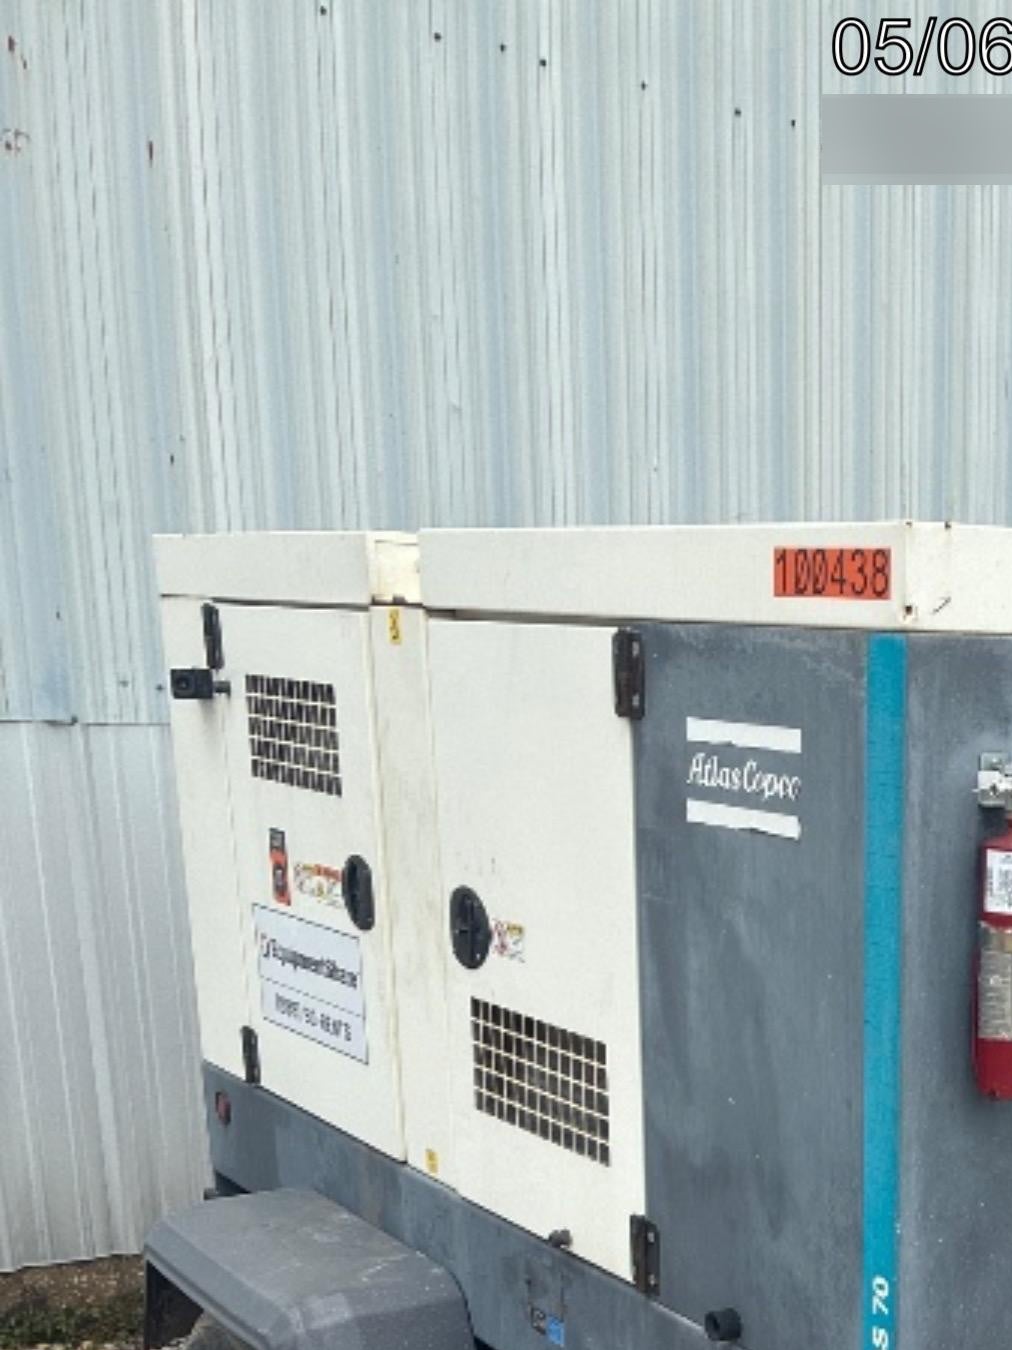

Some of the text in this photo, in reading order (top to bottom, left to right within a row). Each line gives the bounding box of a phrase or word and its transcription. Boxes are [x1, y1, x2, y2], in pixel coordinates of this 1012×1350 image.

[775, 549, 890, 597] 100438
[688, 752, 741, 790] Atlas
[872, 1275, 889, 1315] 70
